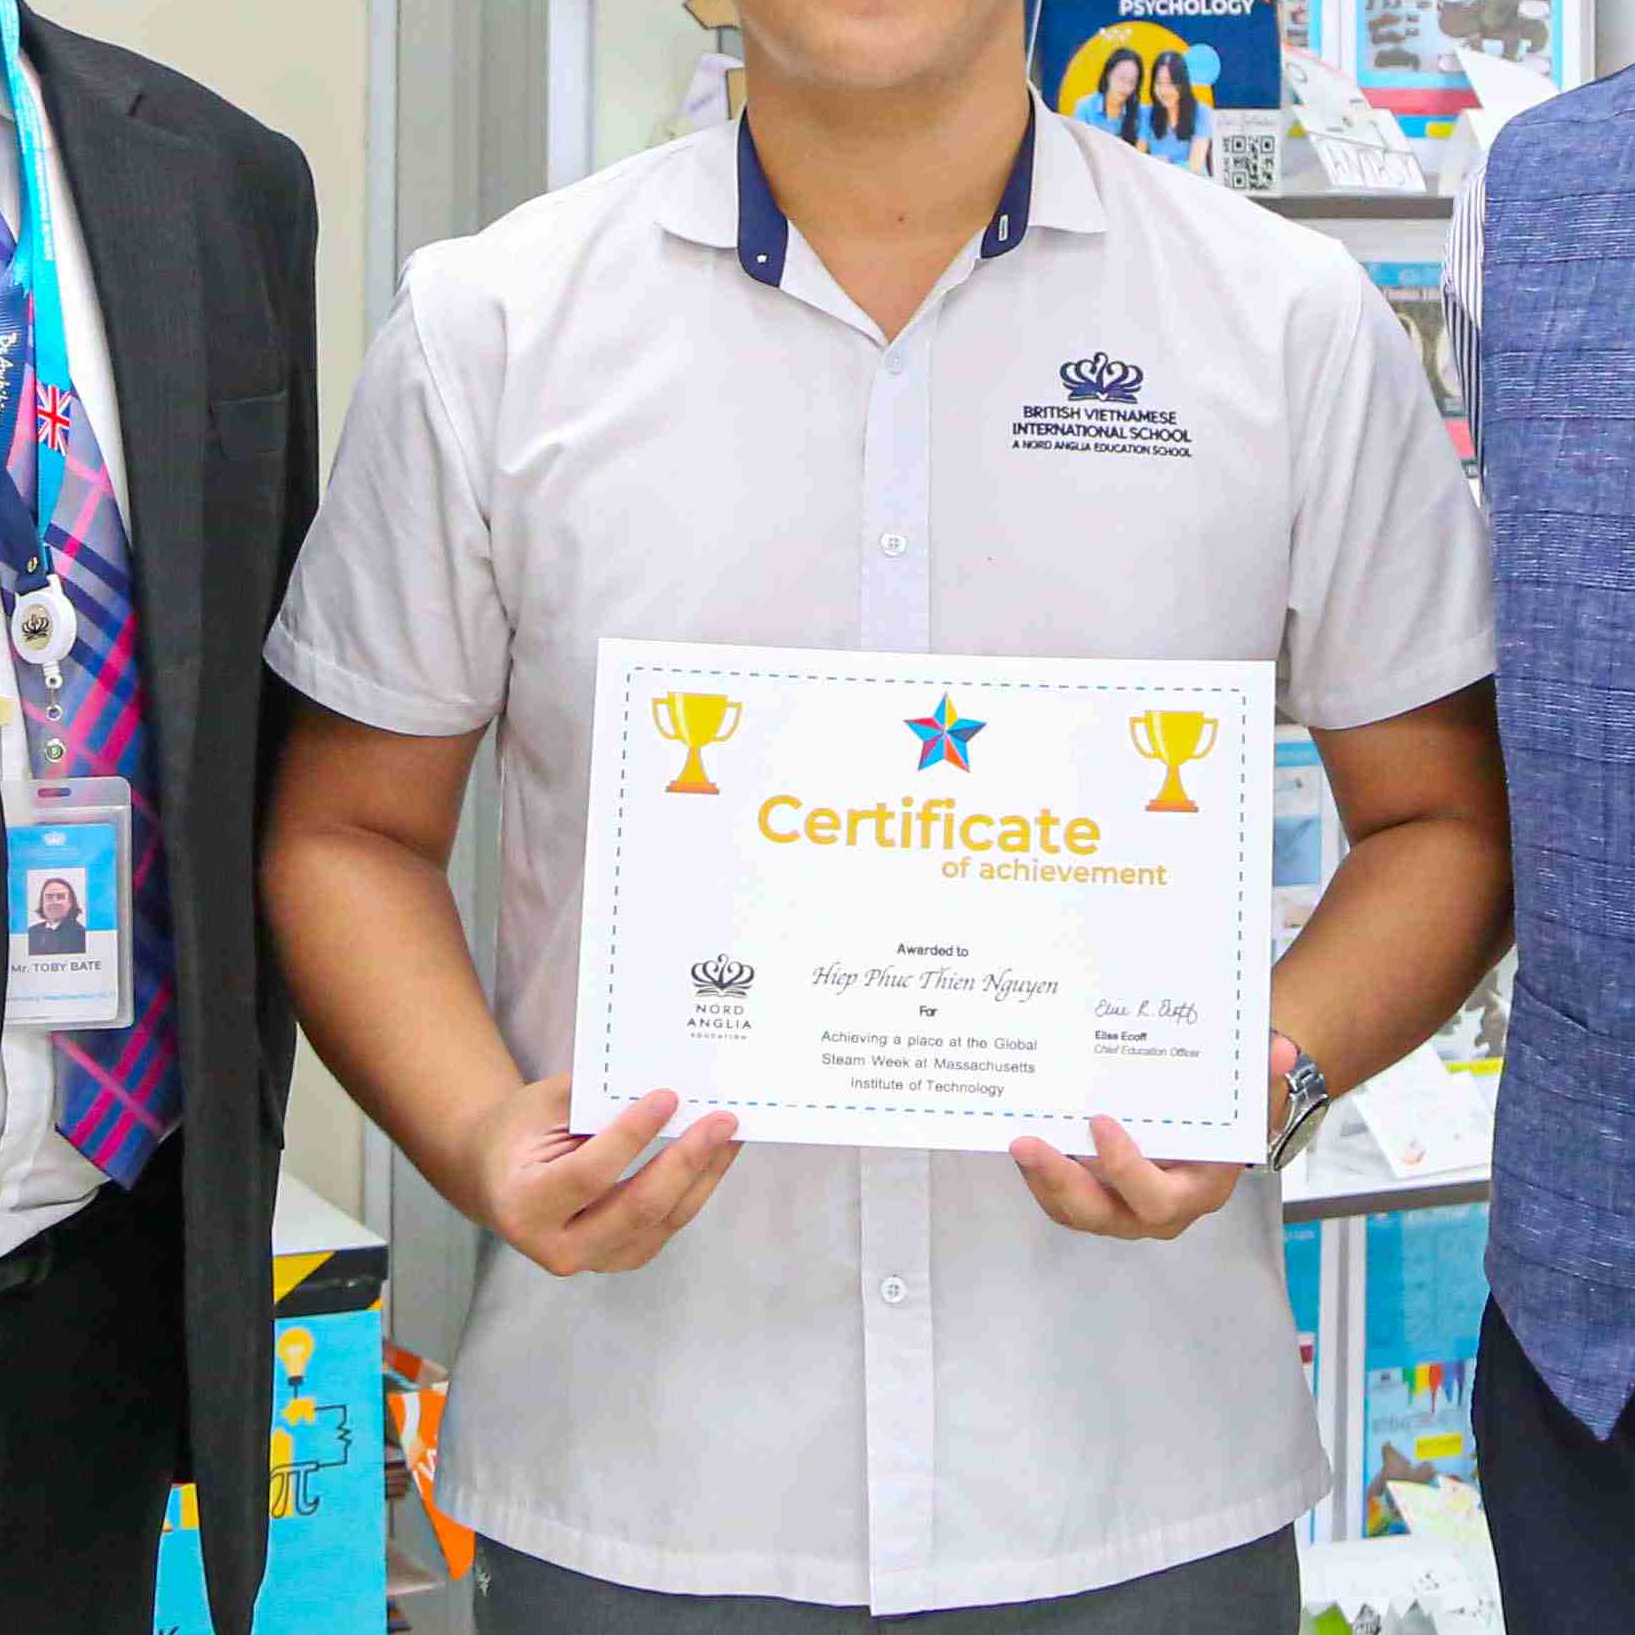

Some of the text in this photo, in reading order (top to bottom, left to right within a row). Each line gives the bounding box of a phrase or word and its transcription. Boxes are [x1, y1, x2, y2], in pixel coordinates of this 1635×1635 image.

[1023, 406, 1177, 425] BRITISH VIETNAMESE
[1013, 422, 1192, 443] INTERNATIONAL SCHOOL
[1012, 440, 1192, 458] A NORD ANGLIA EDUCATION SCHOOL
[758, 794, 1101, 855] Certificate
[941, 856, 1167, 885] of achievement
[897, 943, 969, 957] Awarded to
[32, 962, 67, 973] TOBY
[69, 961, 102, 971] BATE
[812, 961, 1059, 1003] Hiep Phuc Thien Nguyen
[696, 1005, 744, 1015] NORD
[919, 1005, 938, 1017] For
[686, 1018, 752, 1029] ANGLIA
[821, 1030, 1037, 1051] Achieving a place at the Global
[821, 1052, 1036, 1074] Steam Week at Massachusetts
[851, 1077, 1004, 1097] Institute of Technology
